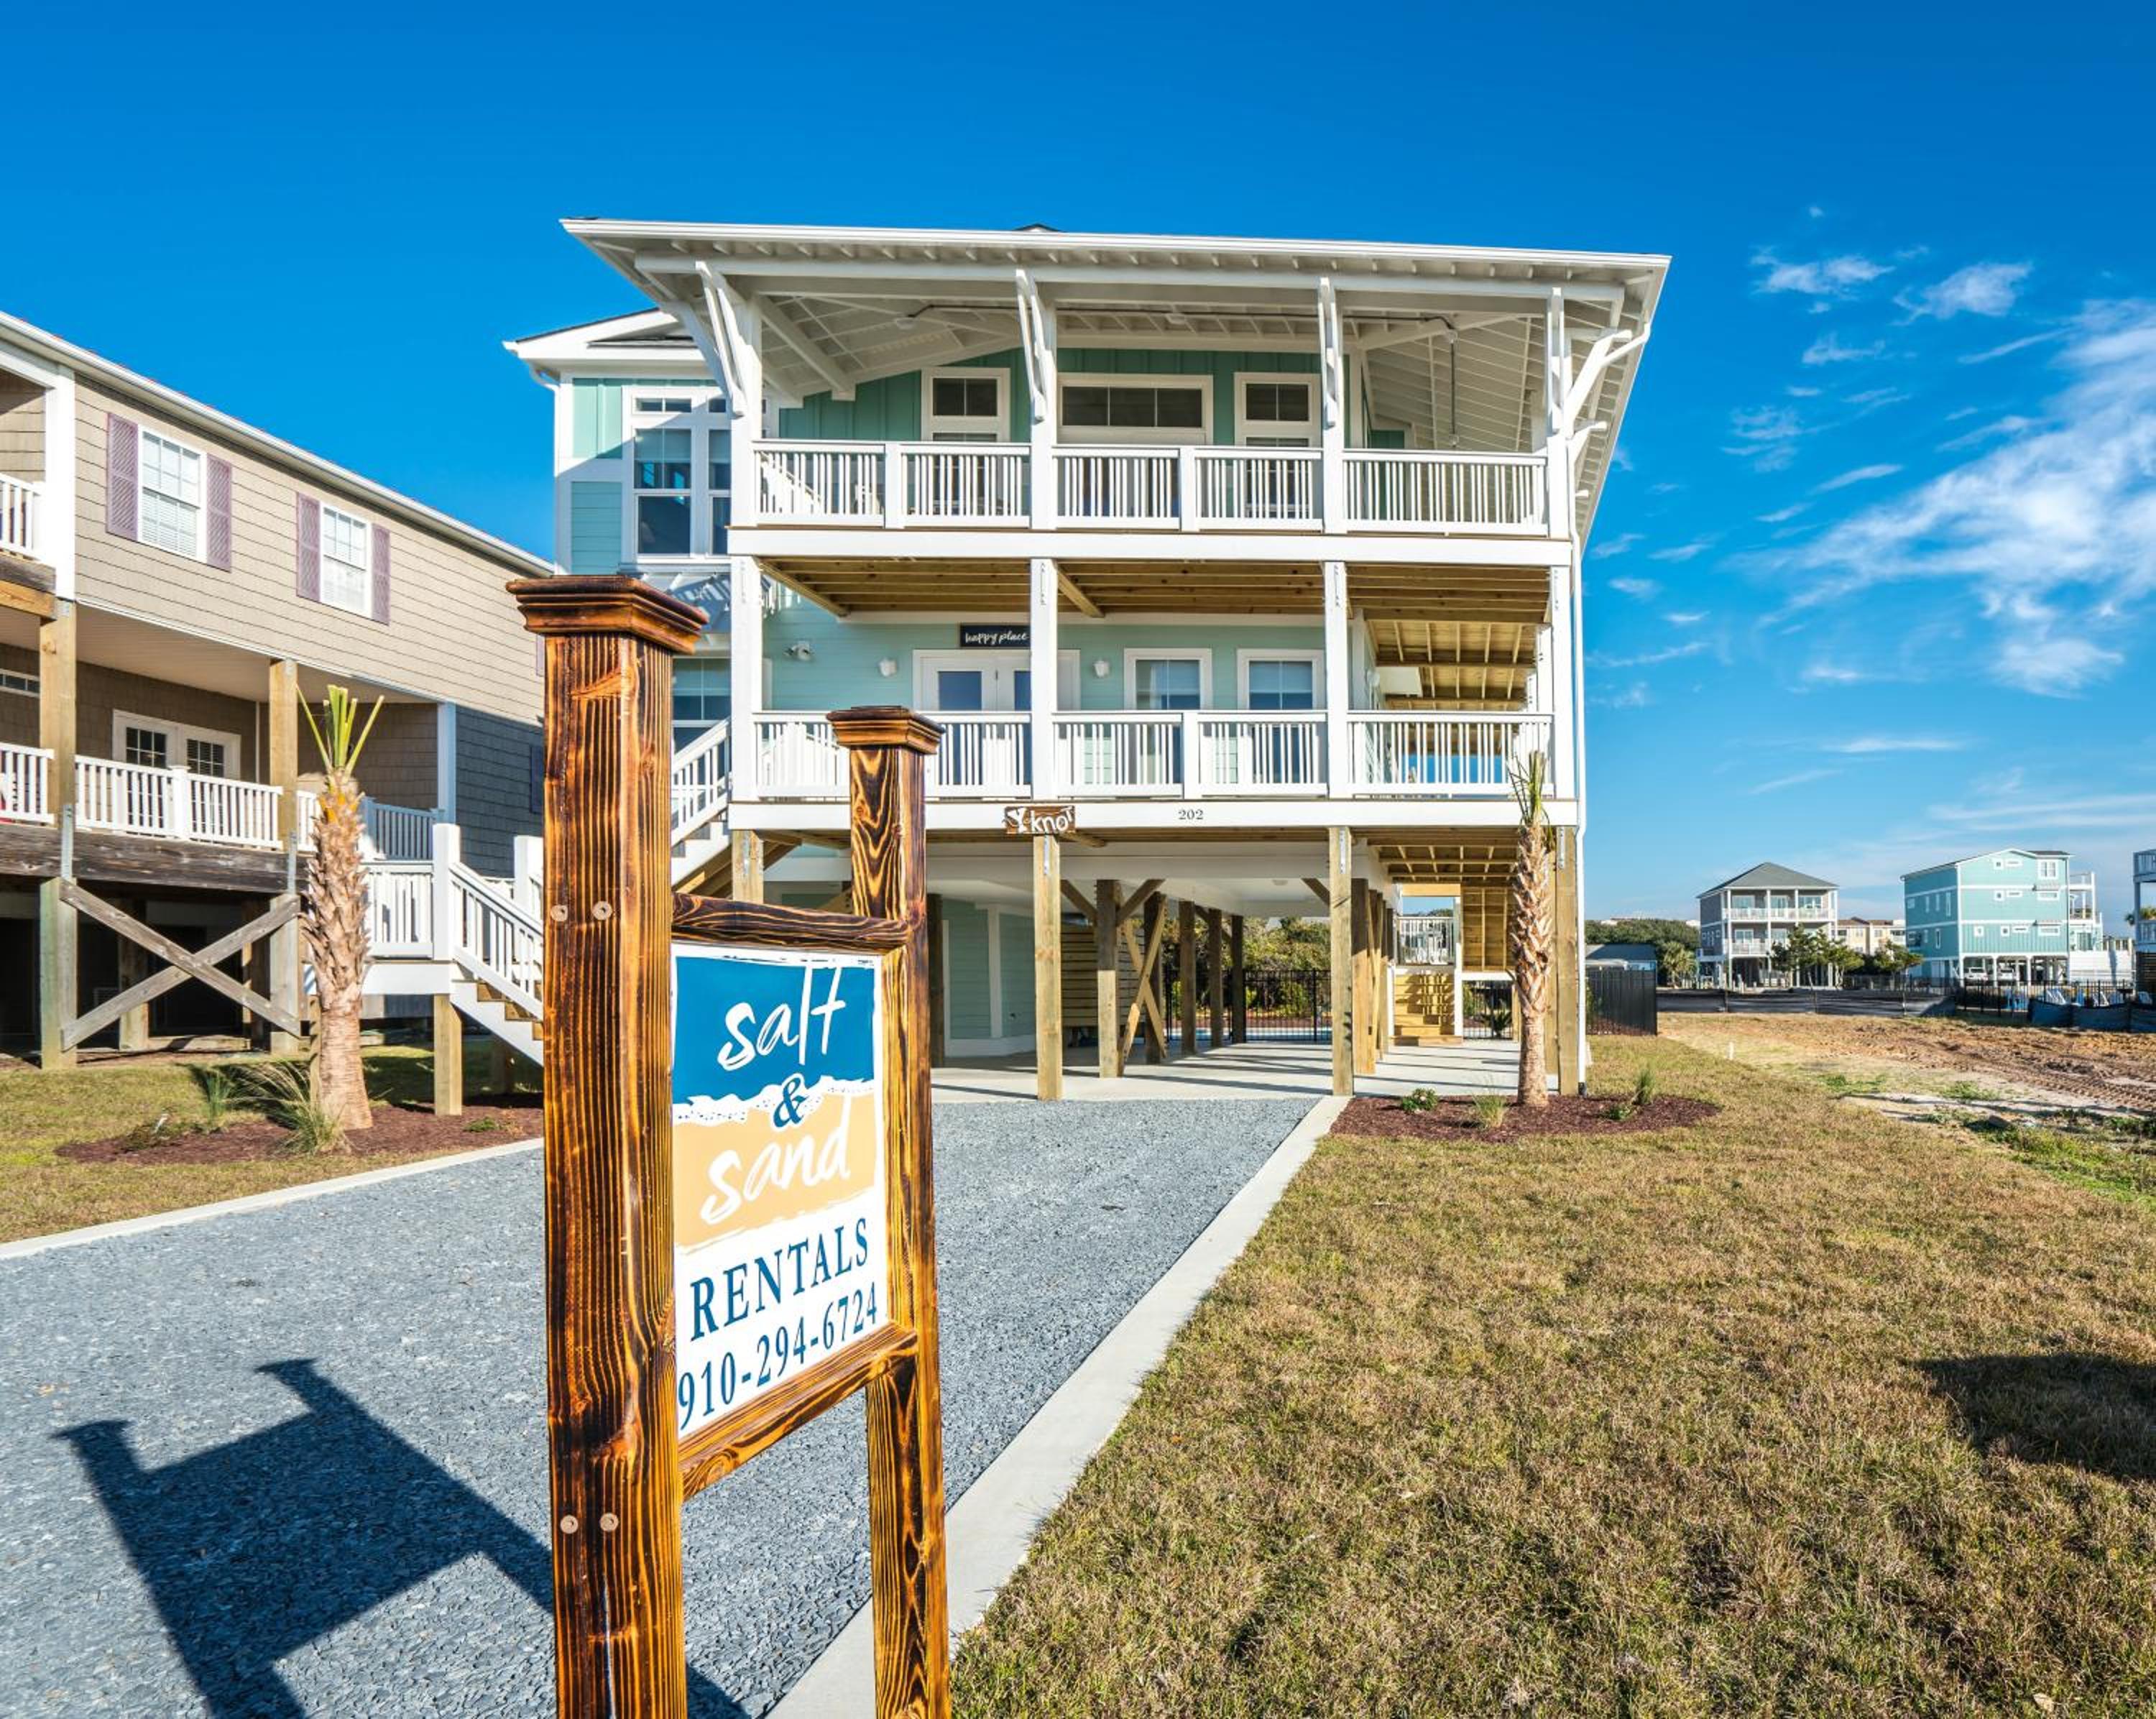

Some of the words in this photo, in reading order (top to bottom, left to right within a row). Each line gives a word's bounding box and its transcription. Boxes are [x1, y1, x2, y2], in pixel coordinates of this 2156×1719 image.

[965, 632, 997, 645] happy
[998, 630, 1028, 644] place
[1178, 808, 1203, 820] 202
[717, 964, 847, 1071] salt
[773, 1073, 807, 1128] &
[699, 1096, 852, 1225] sand
[690, 1217, 869, 1342] RENTALS
[678, 1281, 878, 1432] 910-294-6724
